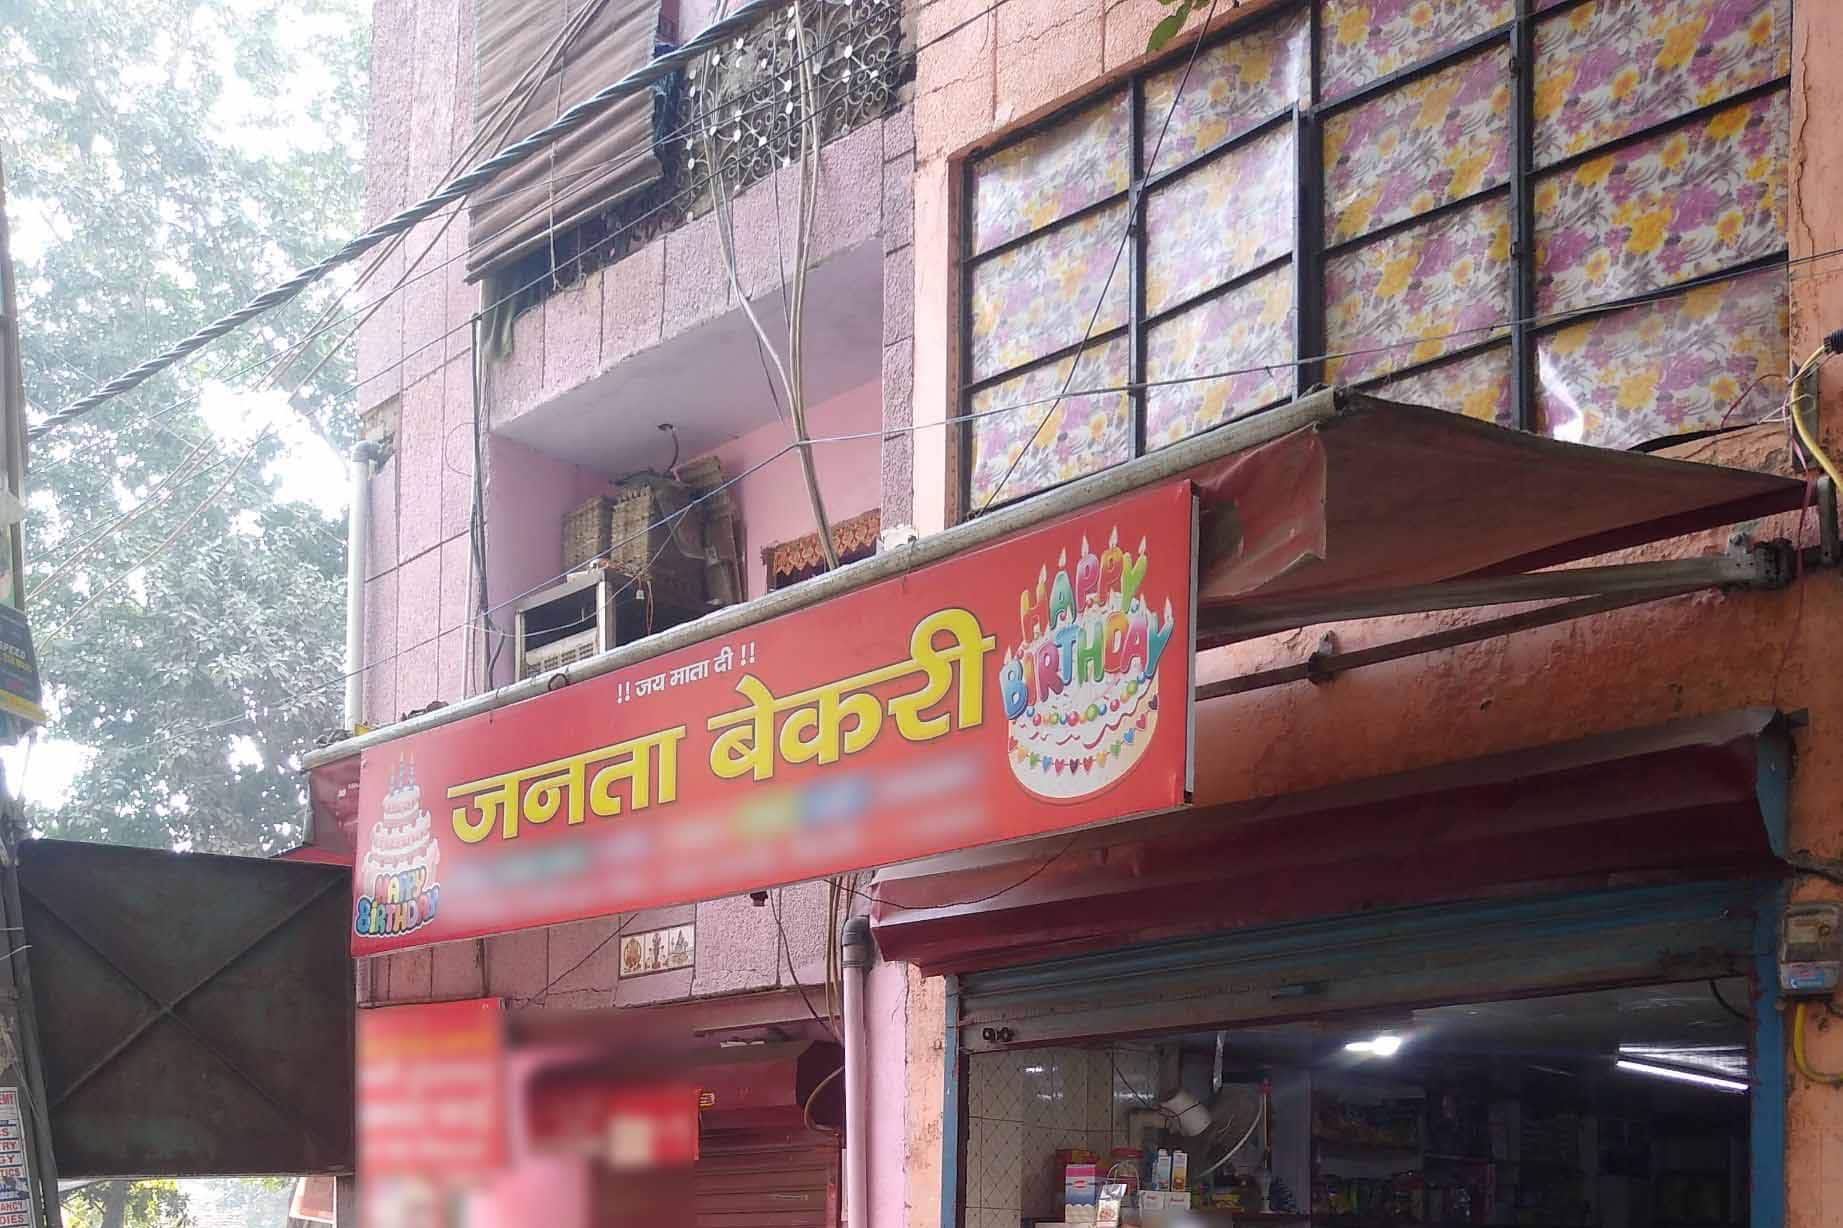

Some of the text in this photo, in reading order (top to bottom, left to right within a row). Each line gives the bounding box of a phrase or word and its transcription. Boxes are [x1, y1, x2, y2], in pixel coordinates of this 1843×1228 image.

[1020, 546, 1147, 643] HAPPY
[635, 673, 666, 697] जय
[670, 660, 710, 687] माता
[714, 646, 733, 673] दी
[1000, 611, 1174, 720] BIRTHDAY
[447, 725, 687, 844] जनता
[707, 607, 996, 782] बेकरी
[355, 886, 440, 936] BIRTHDAY
